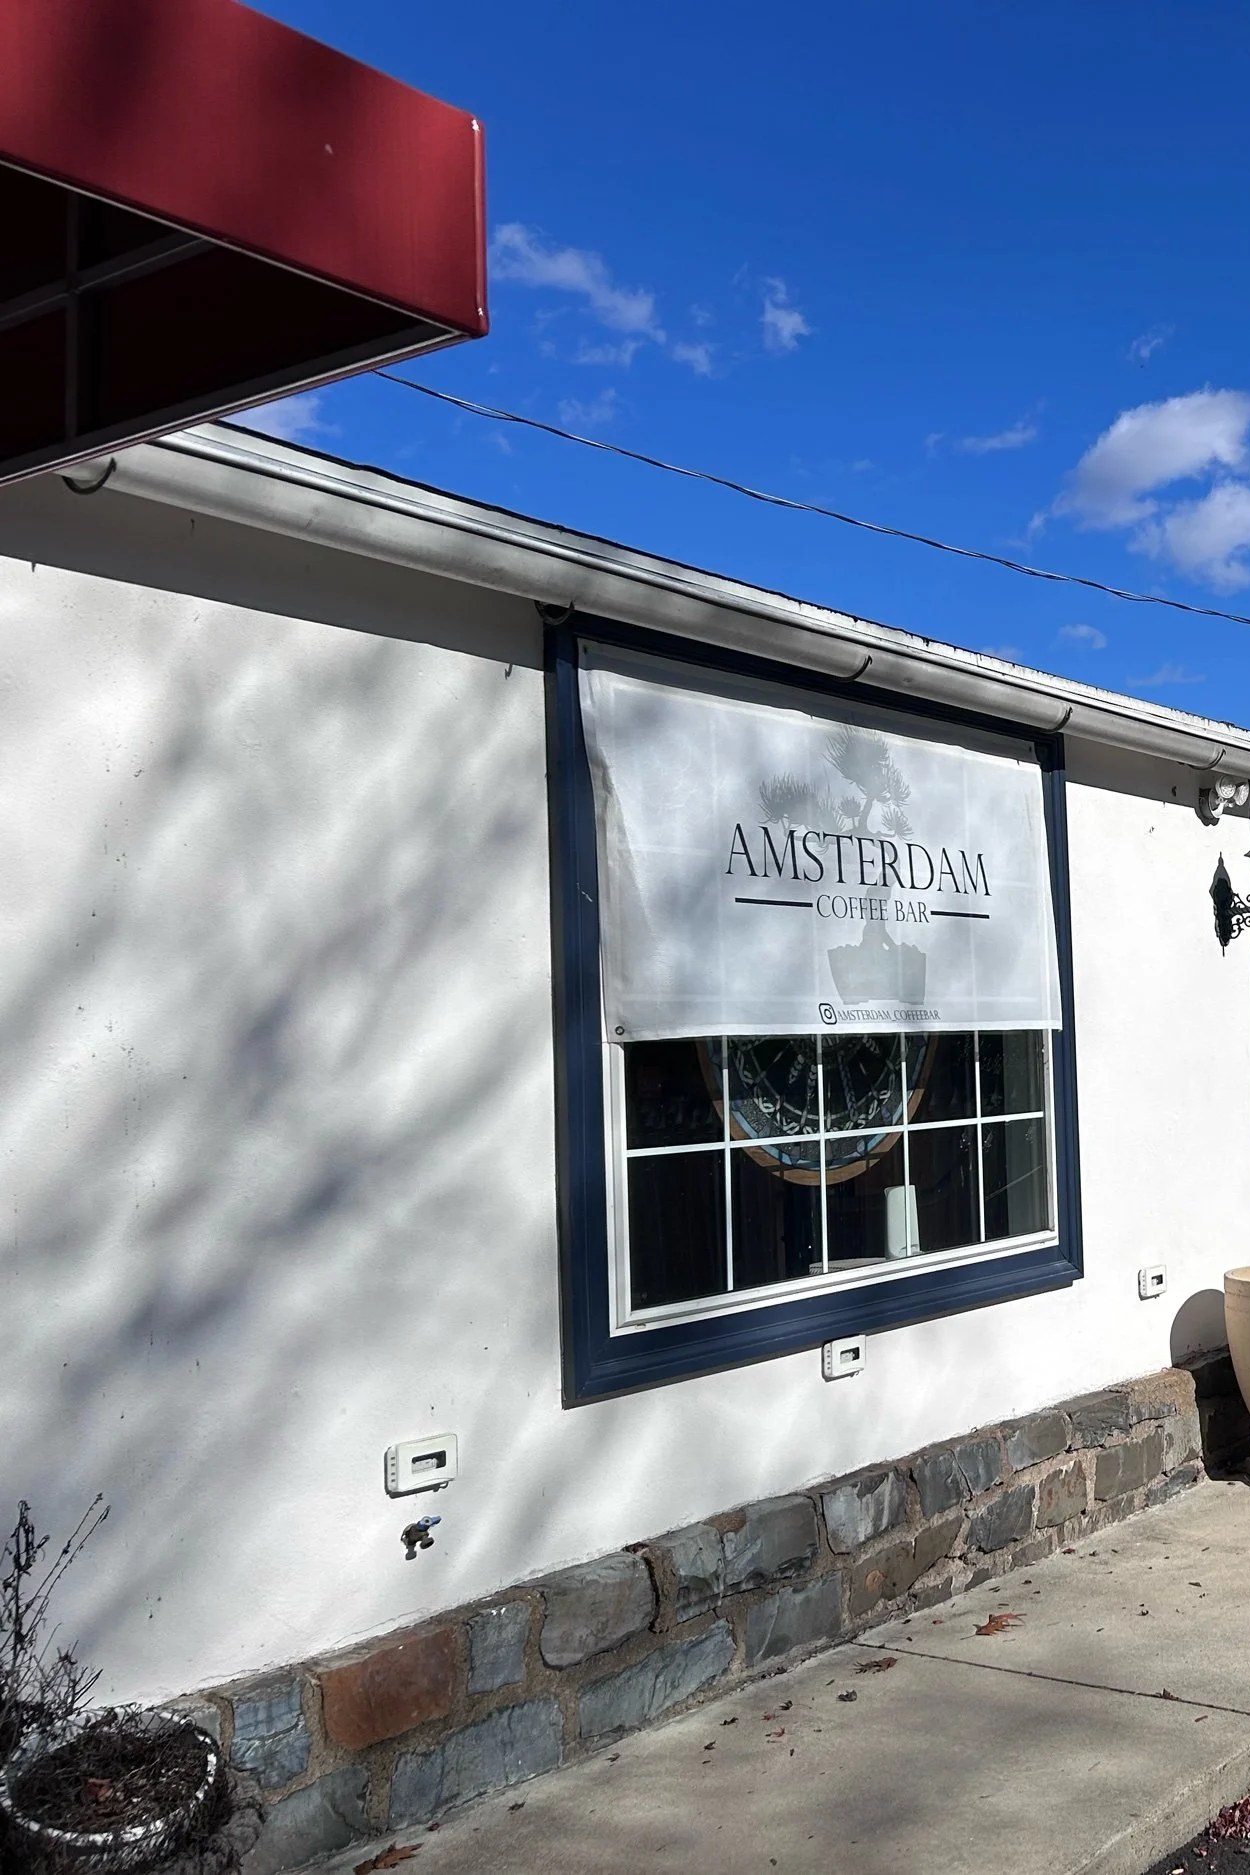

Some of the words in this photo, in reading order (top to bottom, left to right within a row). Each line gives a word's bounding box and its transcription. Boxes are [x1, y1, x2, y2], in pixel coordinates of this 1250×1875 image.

[725, 823, 992, 896] AMSTERDAM
[816, 894, 889, 921] COFFEE
[895, 900, 930, 924] BAR
